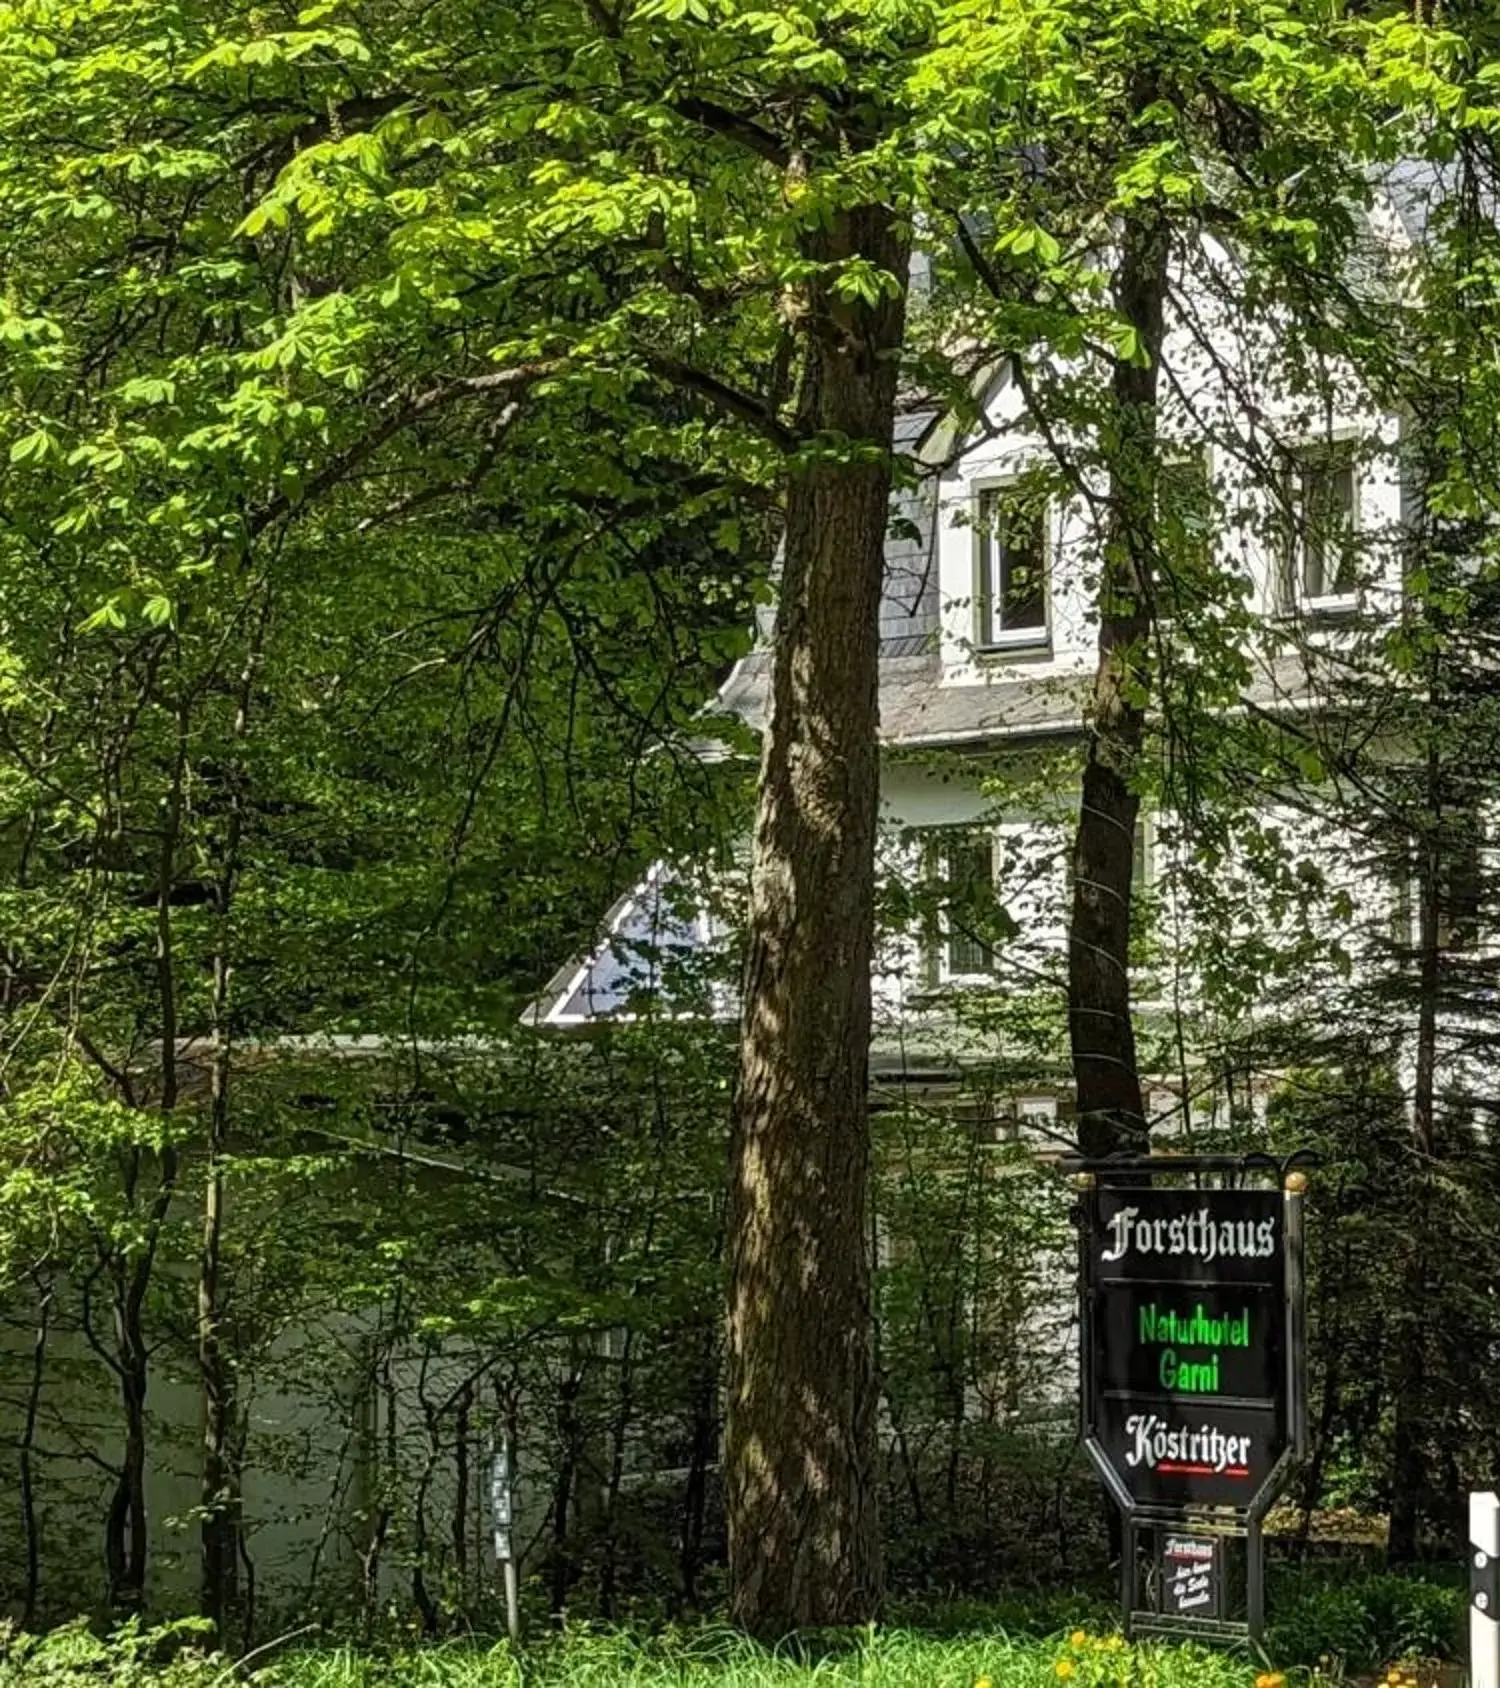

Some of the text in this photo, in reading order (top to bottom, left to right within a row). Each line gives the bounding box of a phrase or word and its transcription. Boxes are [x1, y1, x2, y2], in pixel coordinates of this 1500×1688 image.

[1101, 1206, 1275, 1263] Forsthaus
[1139, 1303, 1249, 1347] Naturhotel
[1159, 1348, 1219, 1392] Garni
[1125, 1414, 1252, 1473] Köstritzer
